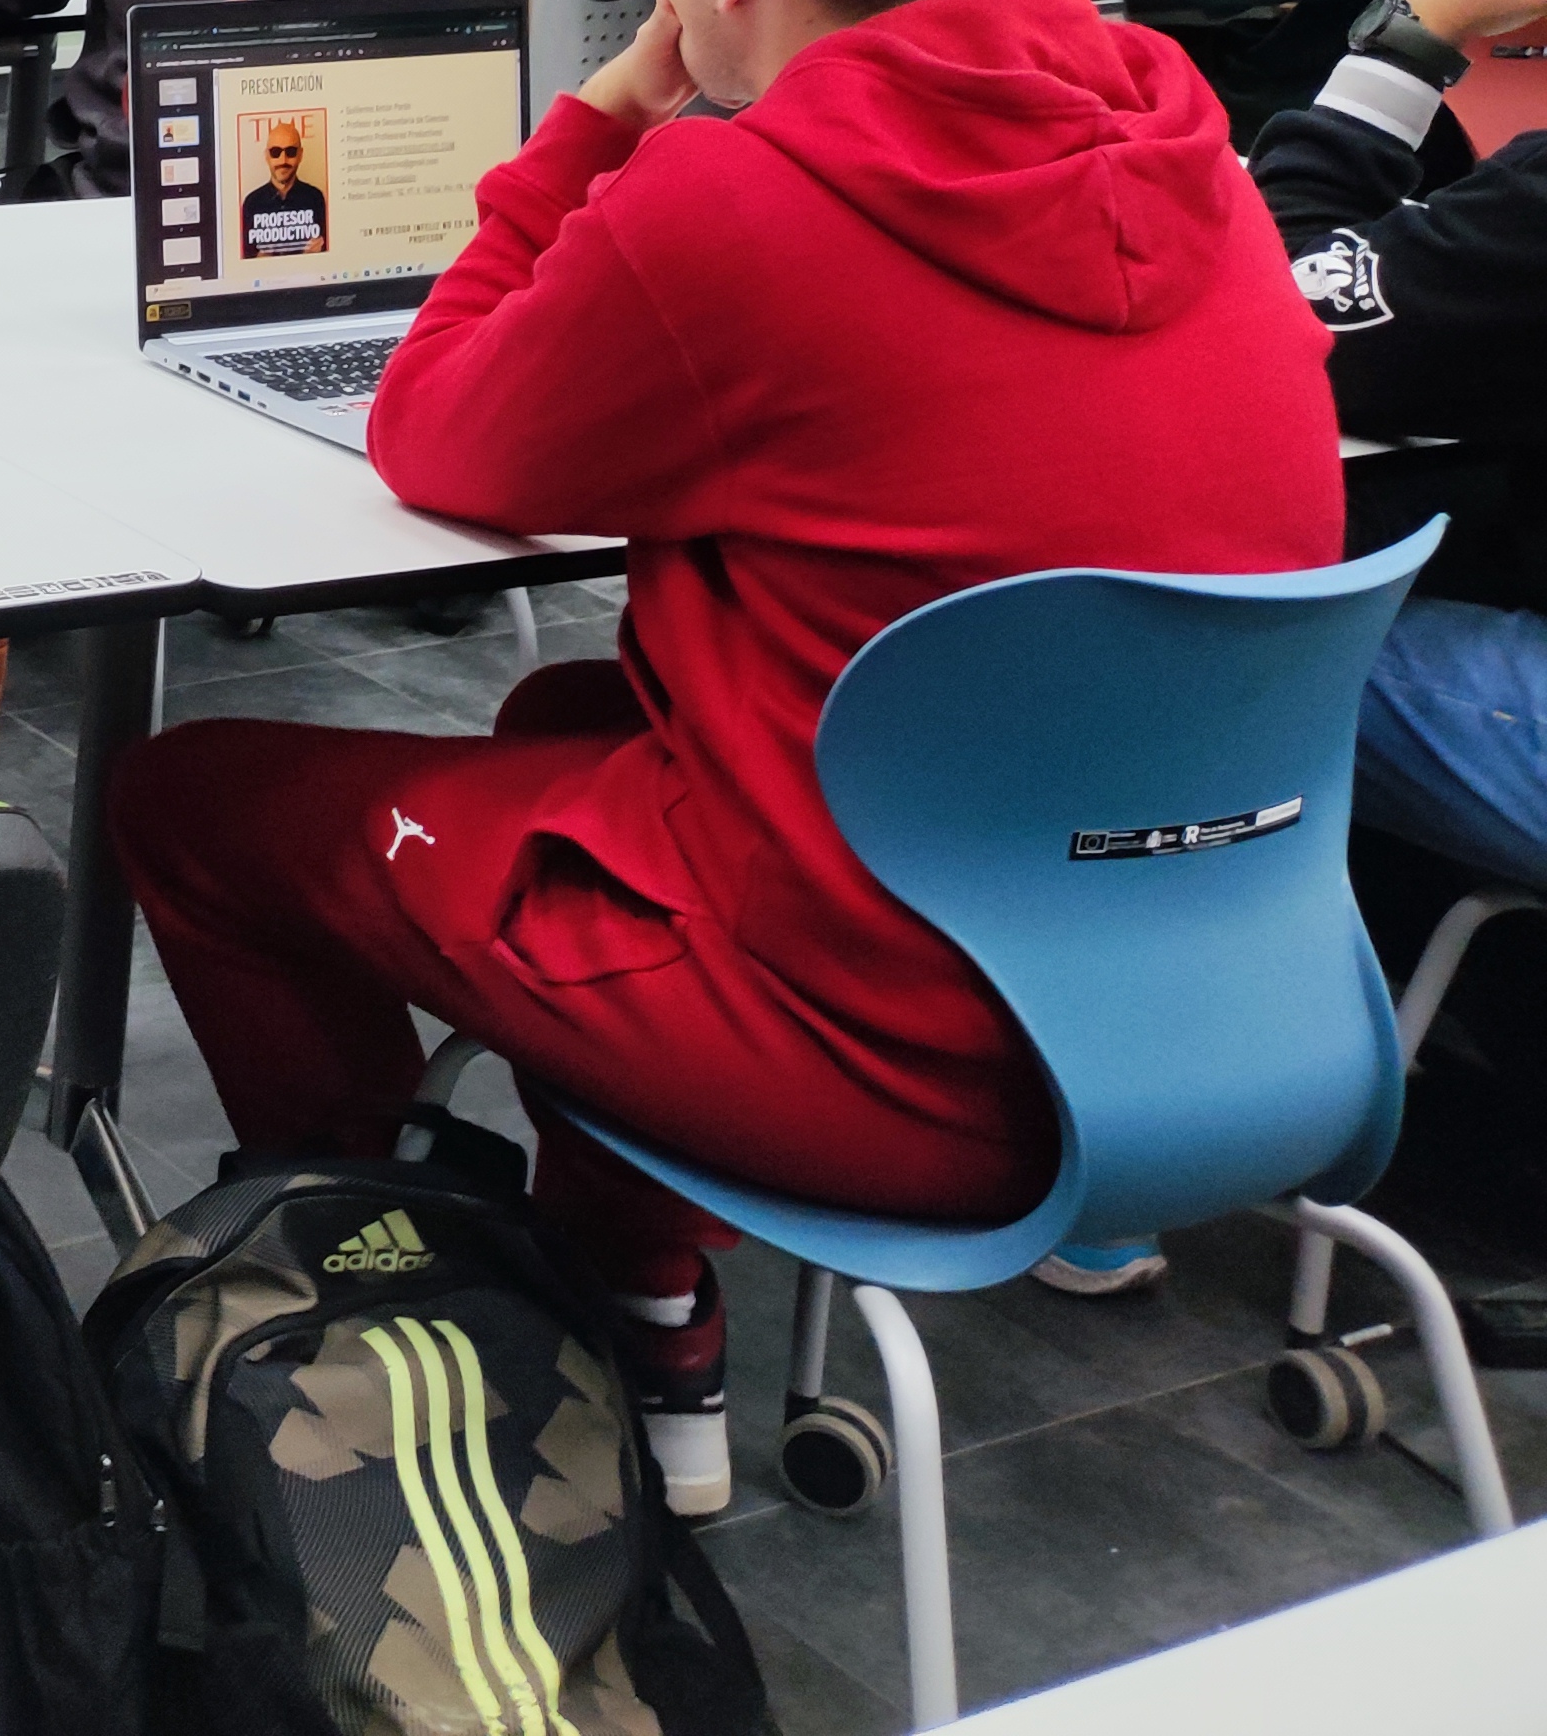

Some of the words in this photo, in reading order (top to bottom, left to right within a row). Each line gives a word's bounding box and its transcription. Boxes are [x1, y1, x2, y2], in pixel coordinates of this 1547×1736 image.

[241, 72, 323, 95] PRESENTACIÓN
[253, 209, 314, 228] PROFESOR
[248, 224, 321, 244] PRODUCTIVO
